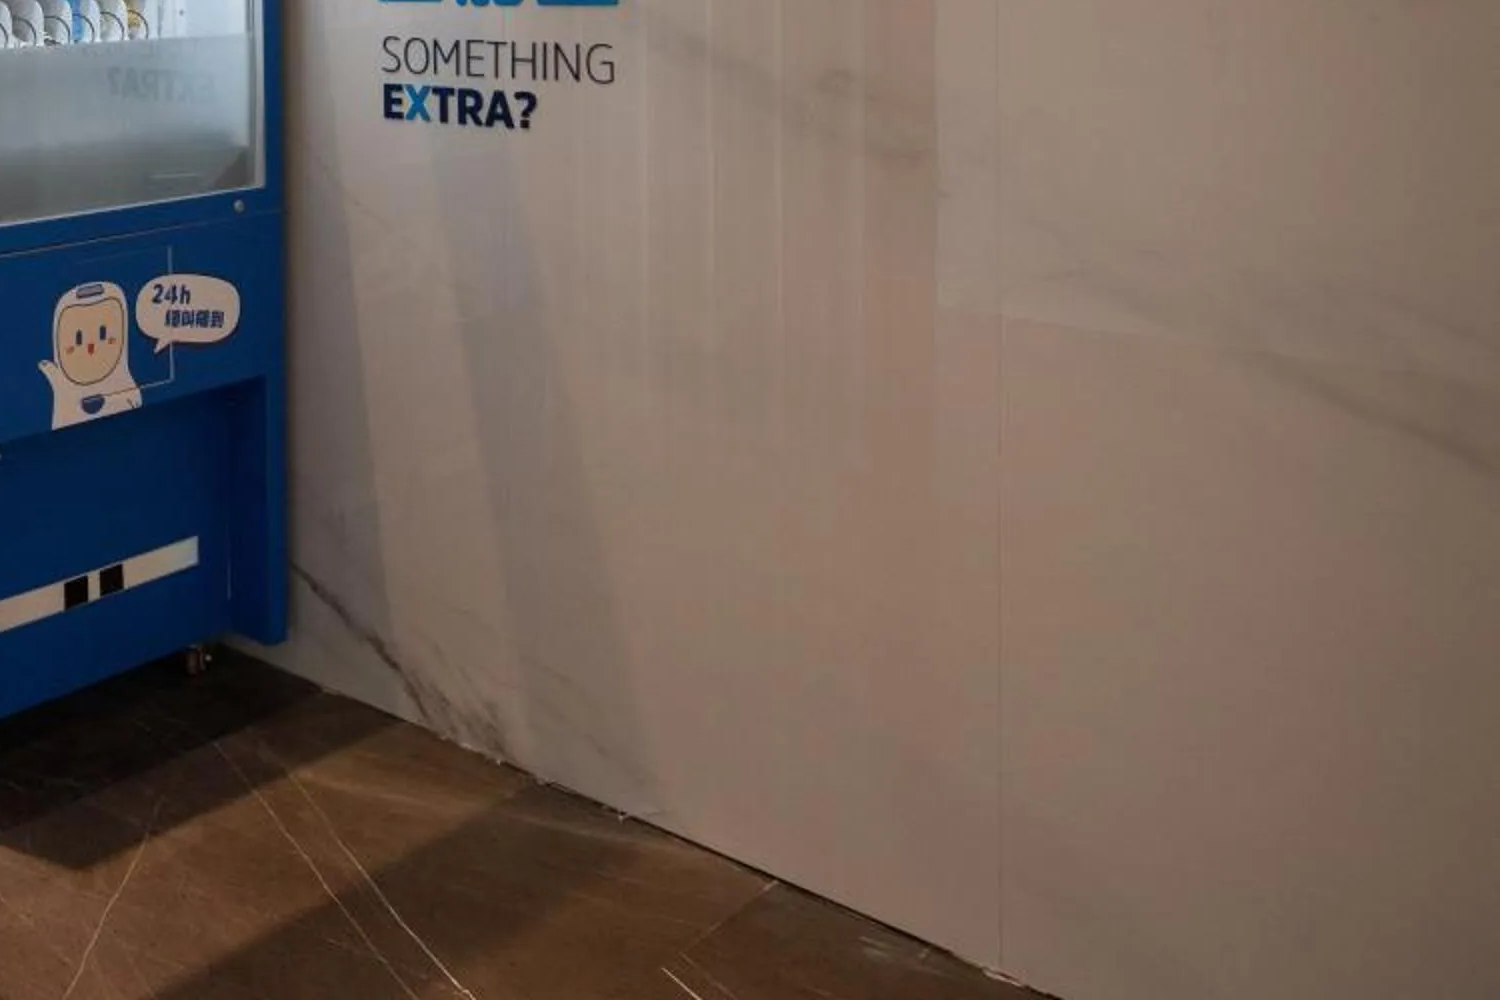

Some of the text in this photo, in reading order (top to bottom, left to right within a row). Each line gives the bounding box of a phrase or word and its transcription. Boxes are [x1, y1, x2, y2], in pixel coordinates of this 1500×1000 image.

[381, 36, 616, 85] SOMETHING
[383, 83, 538, 131] EXTRA?
[152, 284, 191, 304] 24h
